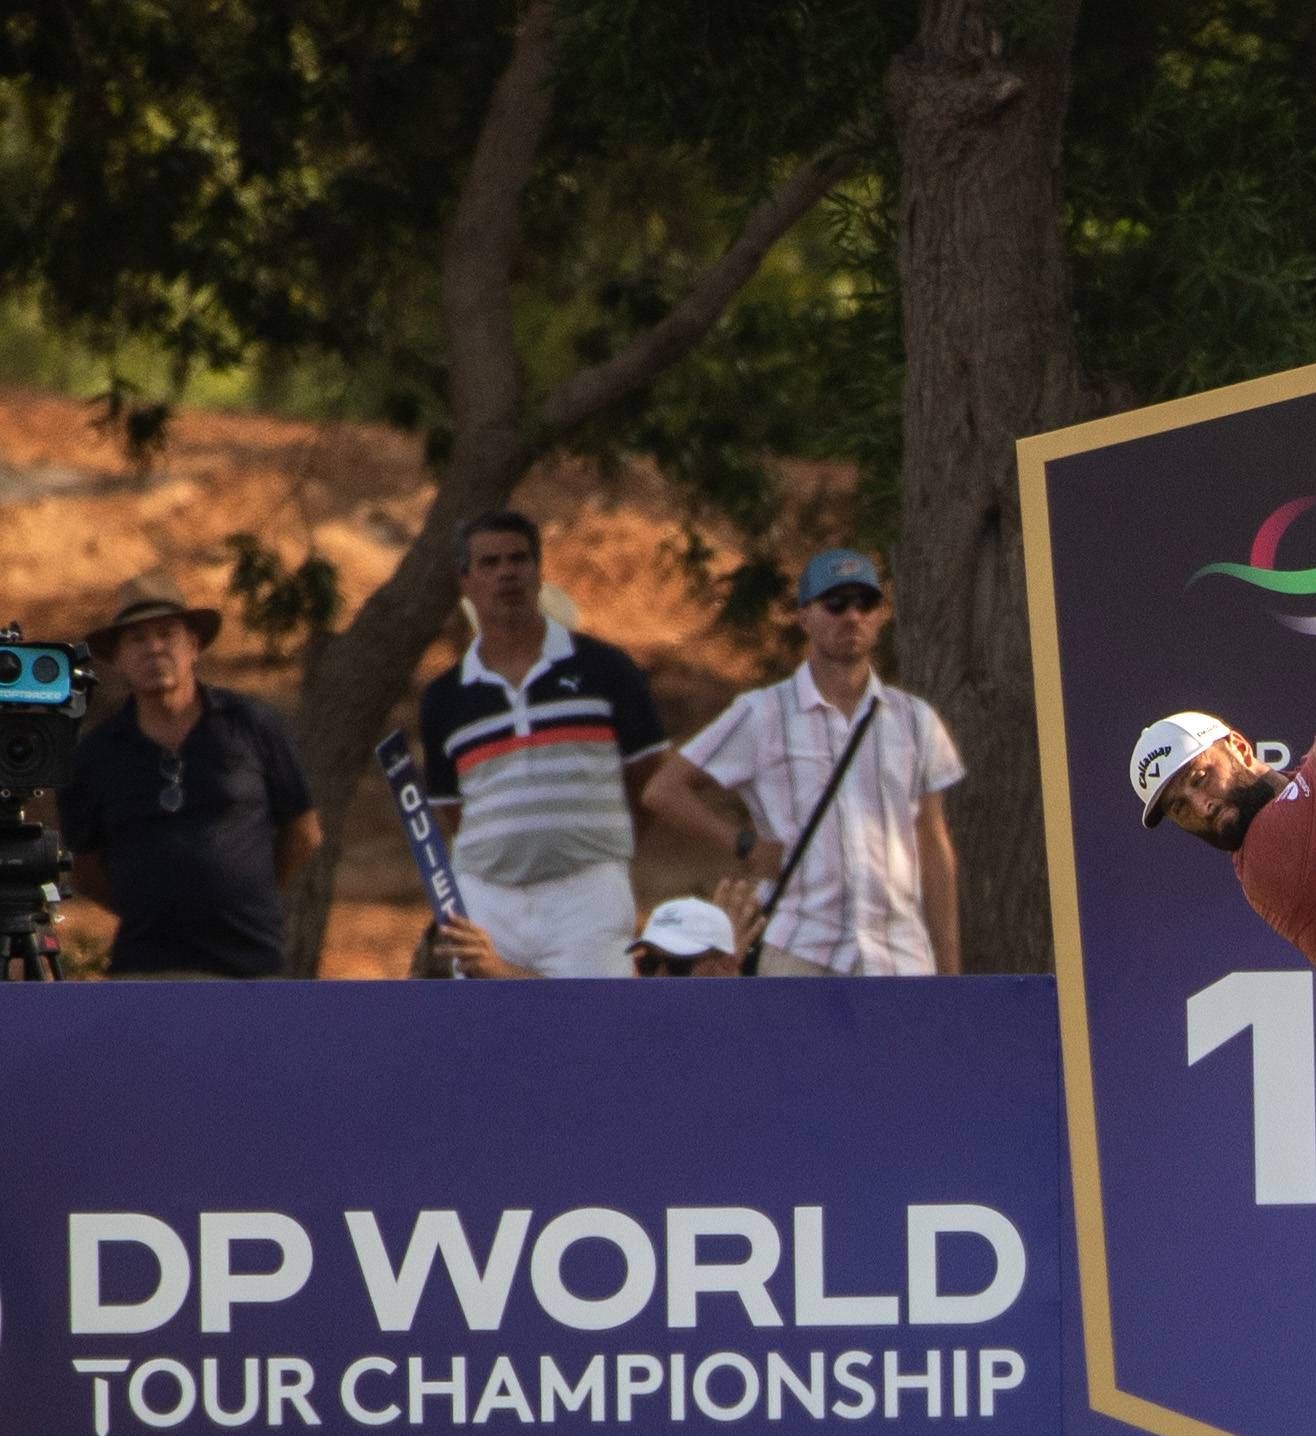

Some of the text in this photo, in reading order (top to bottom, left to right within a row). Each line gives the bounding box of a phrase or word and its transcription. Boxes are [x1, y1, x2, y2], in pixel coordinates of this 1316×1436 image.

[1138, 745, 1172, 790] Callaway
[401, 784, 456, 918] QUIET
[69, 1204, 1026, 1334] DP WORLD
[340, 1349, 1026, 1427] CHAMPIONSHIP
